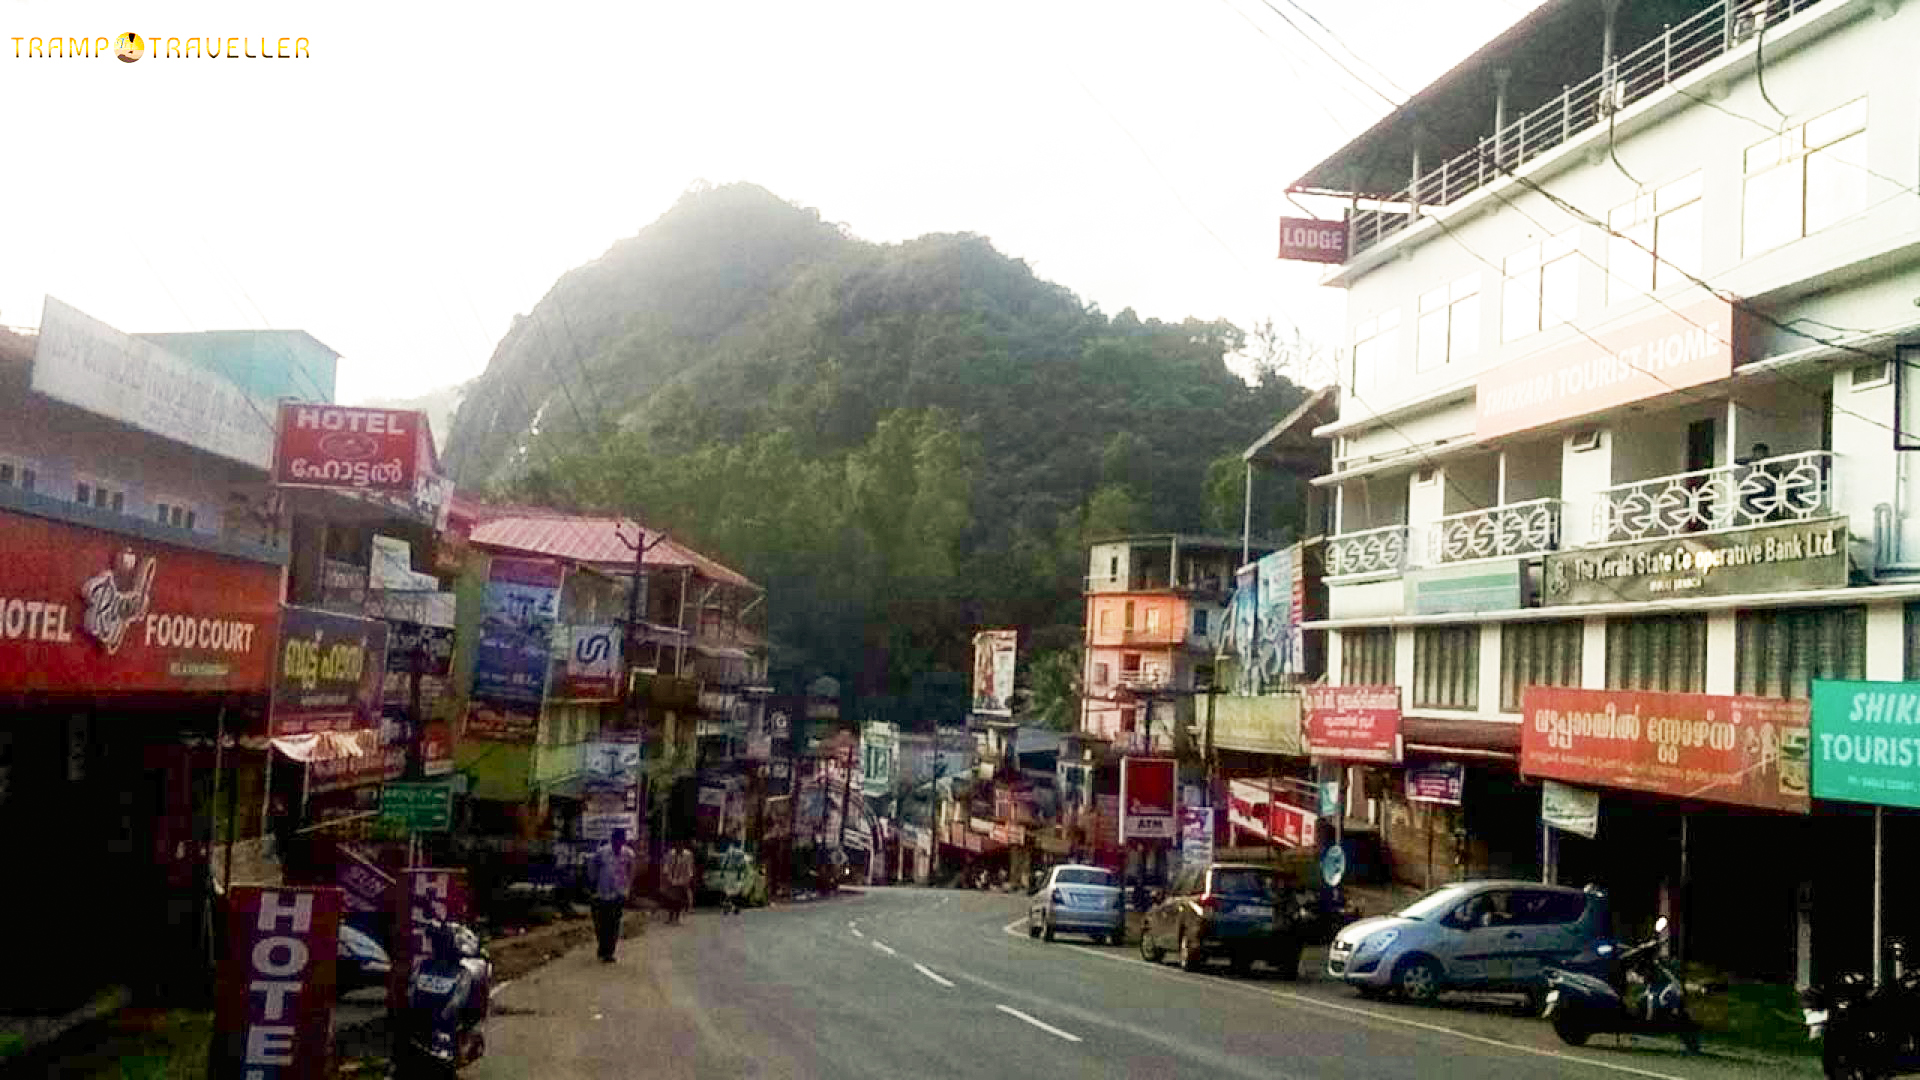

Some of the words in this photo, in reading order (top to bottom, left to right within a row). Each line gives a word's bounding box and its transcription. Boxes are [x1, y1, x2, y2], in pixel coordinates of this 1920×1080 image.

[1283, 227, 1343, 250] LODGE
[1559, 345, 1643, 397] TOURIST
[1647, 321, 1720, 372] HOME
[296, 409, 405, 436] HOTEL
[291, 457, 402, 487] ഹോട്ടൽ
[1574, 557, 1595, 581] The
[1596, 552, 1633, 580] Kerala
[1637, 550, 1672, 575] State
[1765, 532, 1802, 561] Bank
[1806, 528, 1837, 557] Ltd.
[144, 613, 197, 649] FOOD
[199, 617, 256, 654] COURT
[1848, 692, 1920, 725] SHIK
[1137, 819, 1164, 829] ATM
[245, 891, 315, 1080] HOTE
